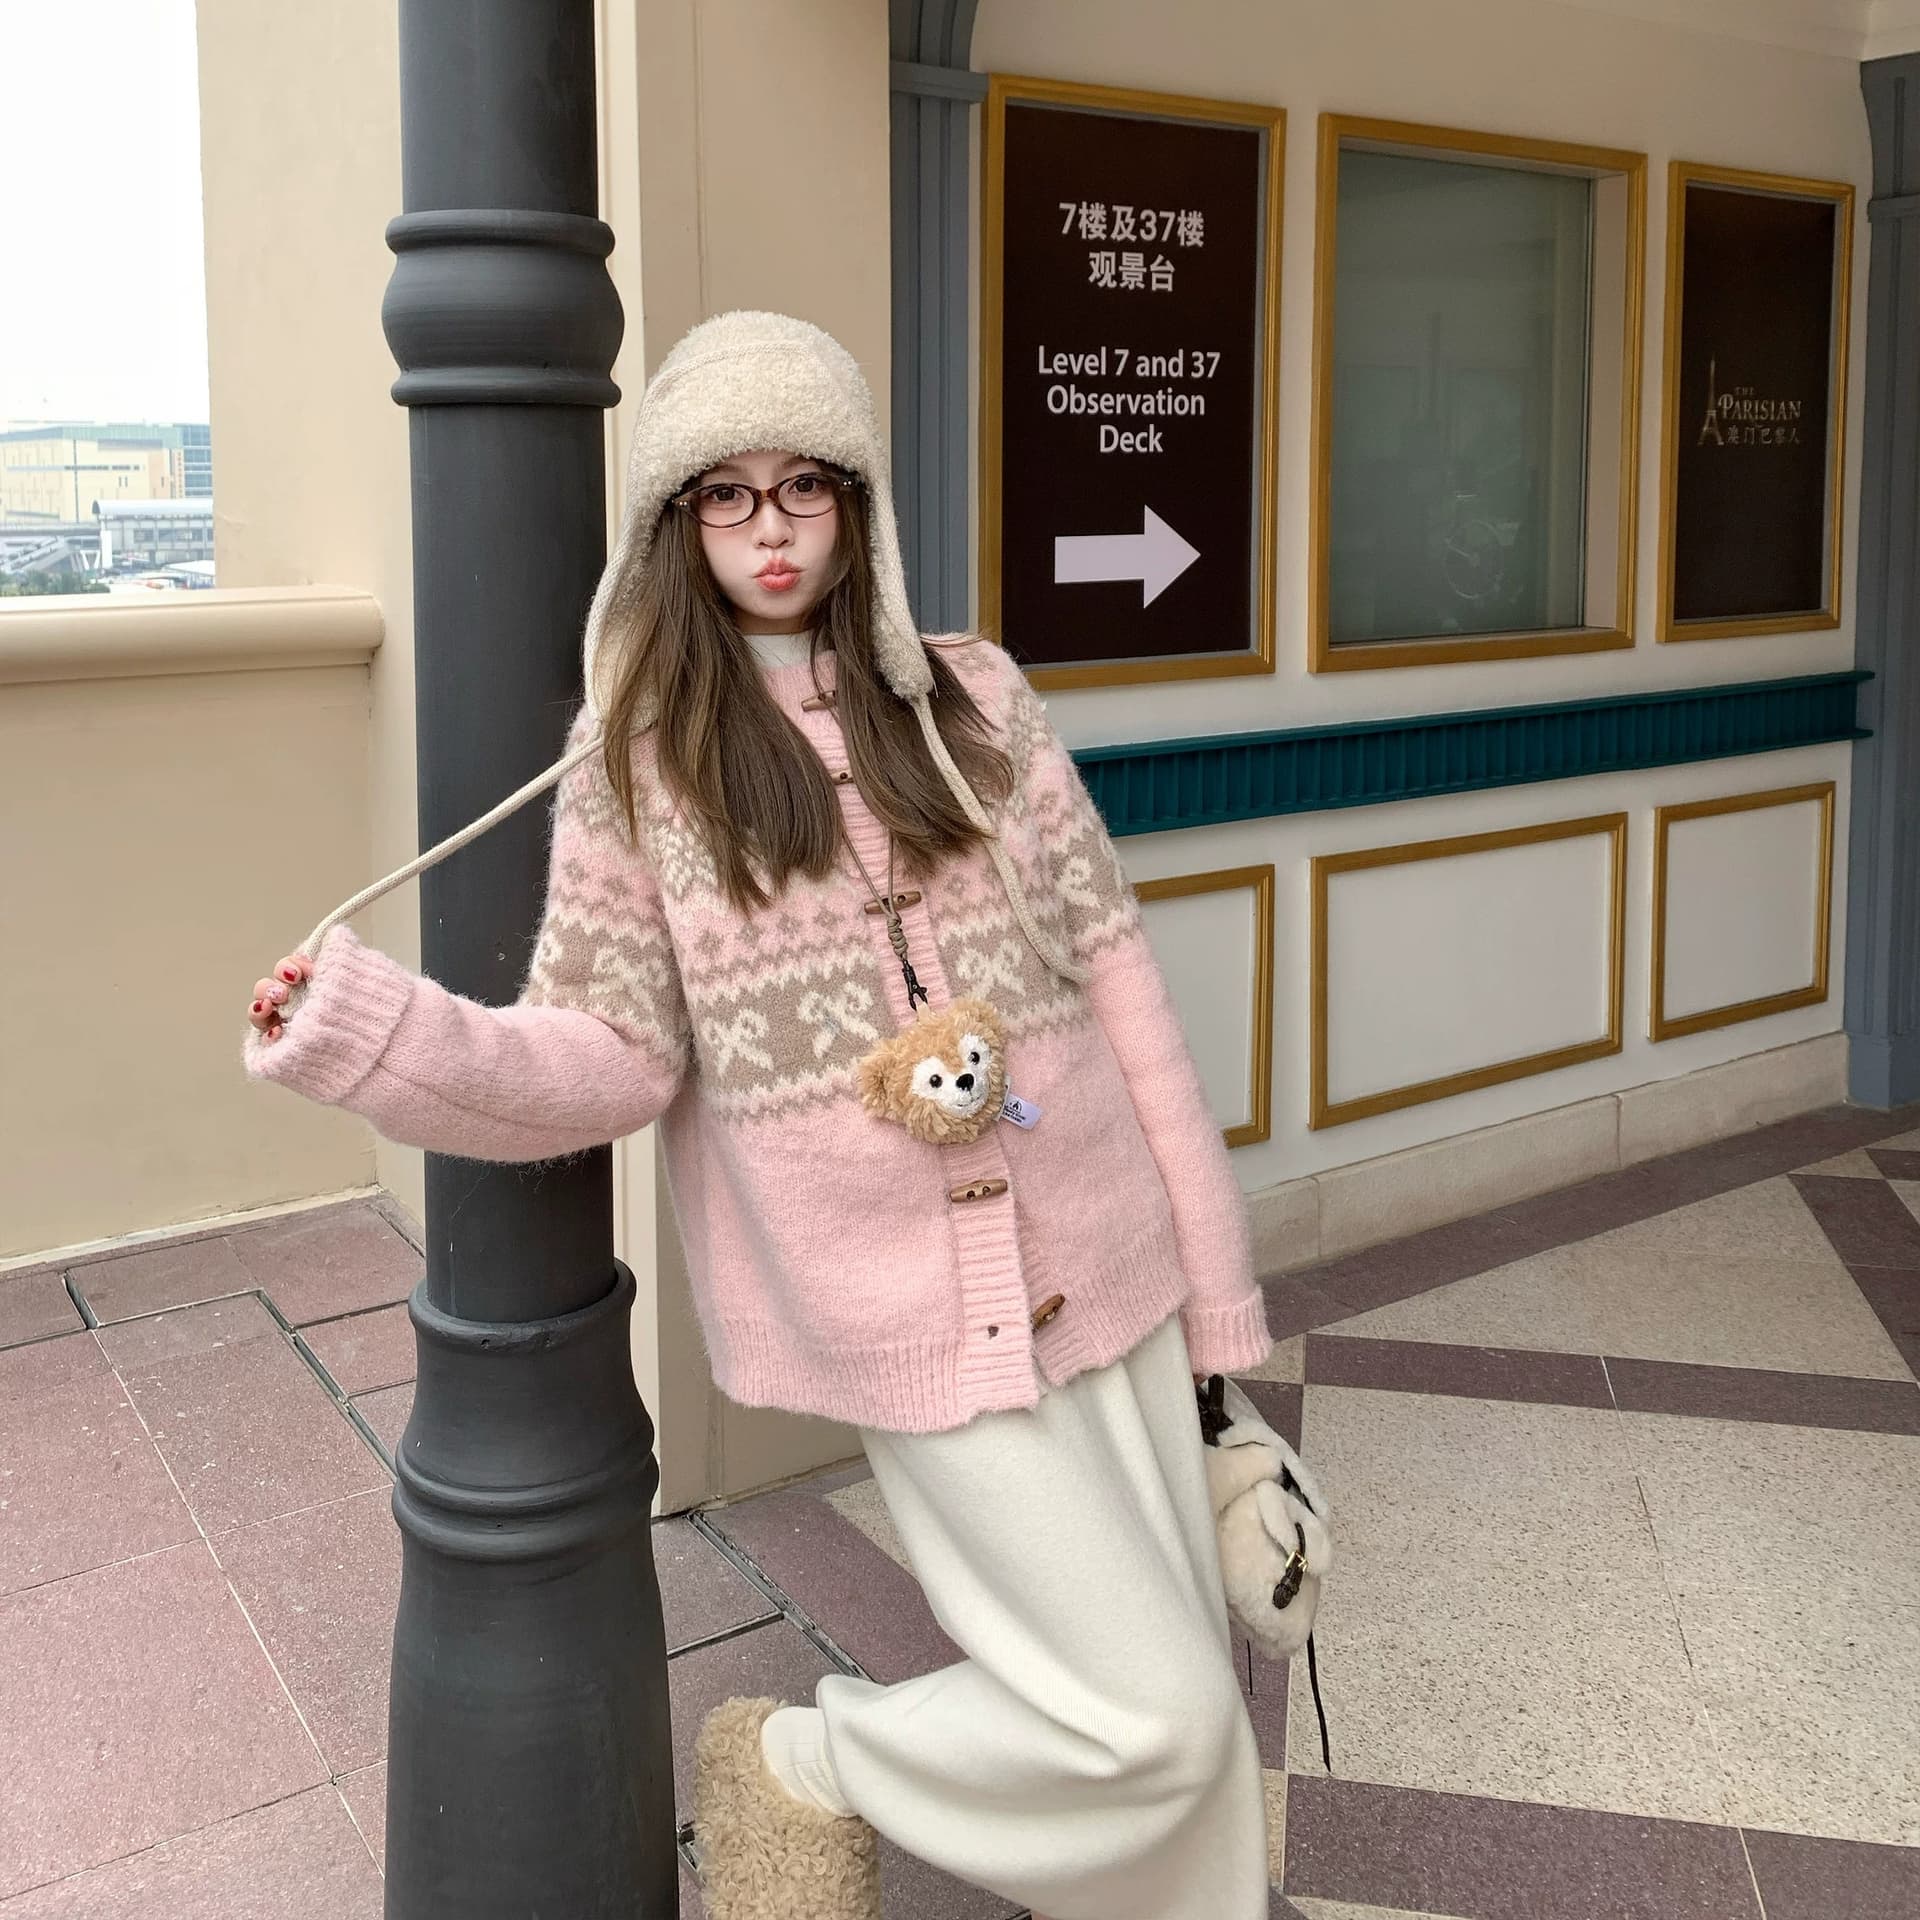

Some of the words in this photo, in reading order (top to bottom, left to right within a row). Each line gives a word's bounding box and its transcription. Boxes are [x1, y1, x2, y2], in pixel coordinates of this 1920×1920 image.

[1059, 201, 1205, 247] 7楼及37楼
[1088, 251, 1175, 291] 观景台
[1038, 345, 1107, 376] Level
[1114, 348, 1129, 376] 7
[1135, 348, 1184, 378] and
[1190, 351, 1221, 378] 37
[1046, 383, 1206, 416] Observation
[1099, 423, 1164, 453] Deck
